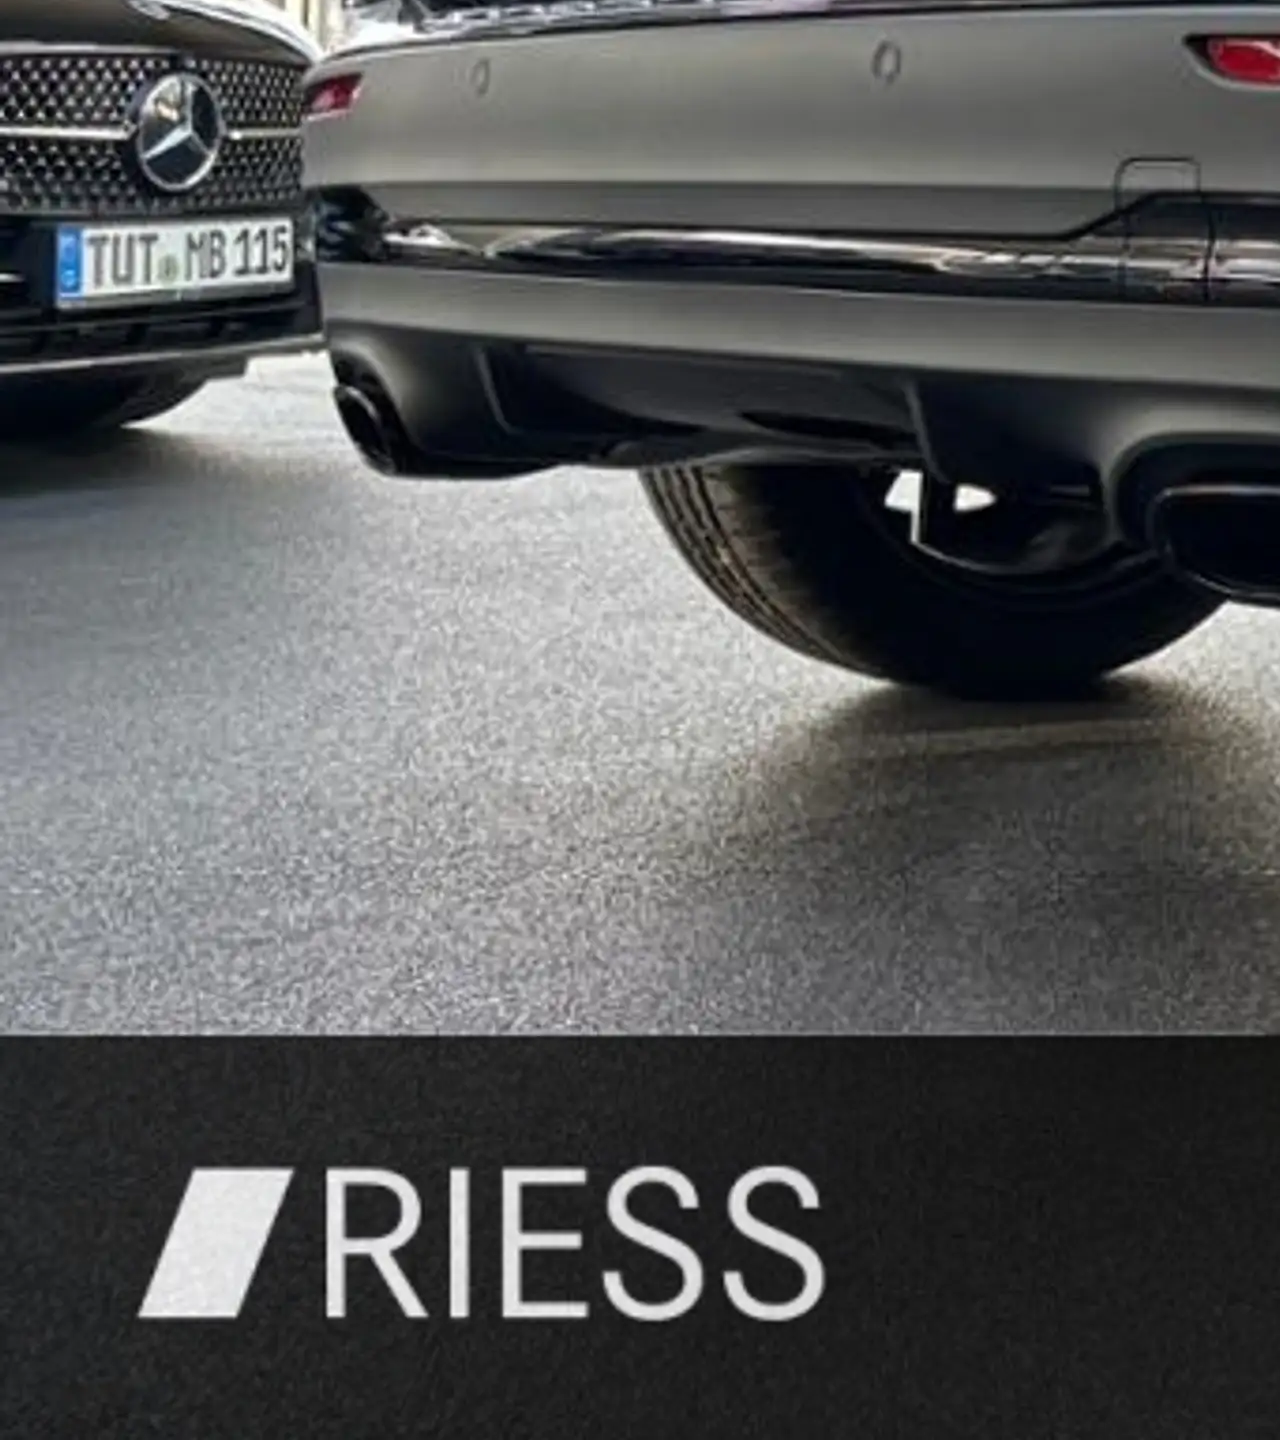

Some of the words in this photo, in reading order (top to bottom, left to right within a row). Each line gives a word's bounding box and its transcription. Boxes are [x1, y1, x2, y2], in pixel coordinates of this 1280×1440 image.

[86, 232, 159, 288] TUT
[185, 229, 226, 281] MB
[233, 225, 288, 277] 115
